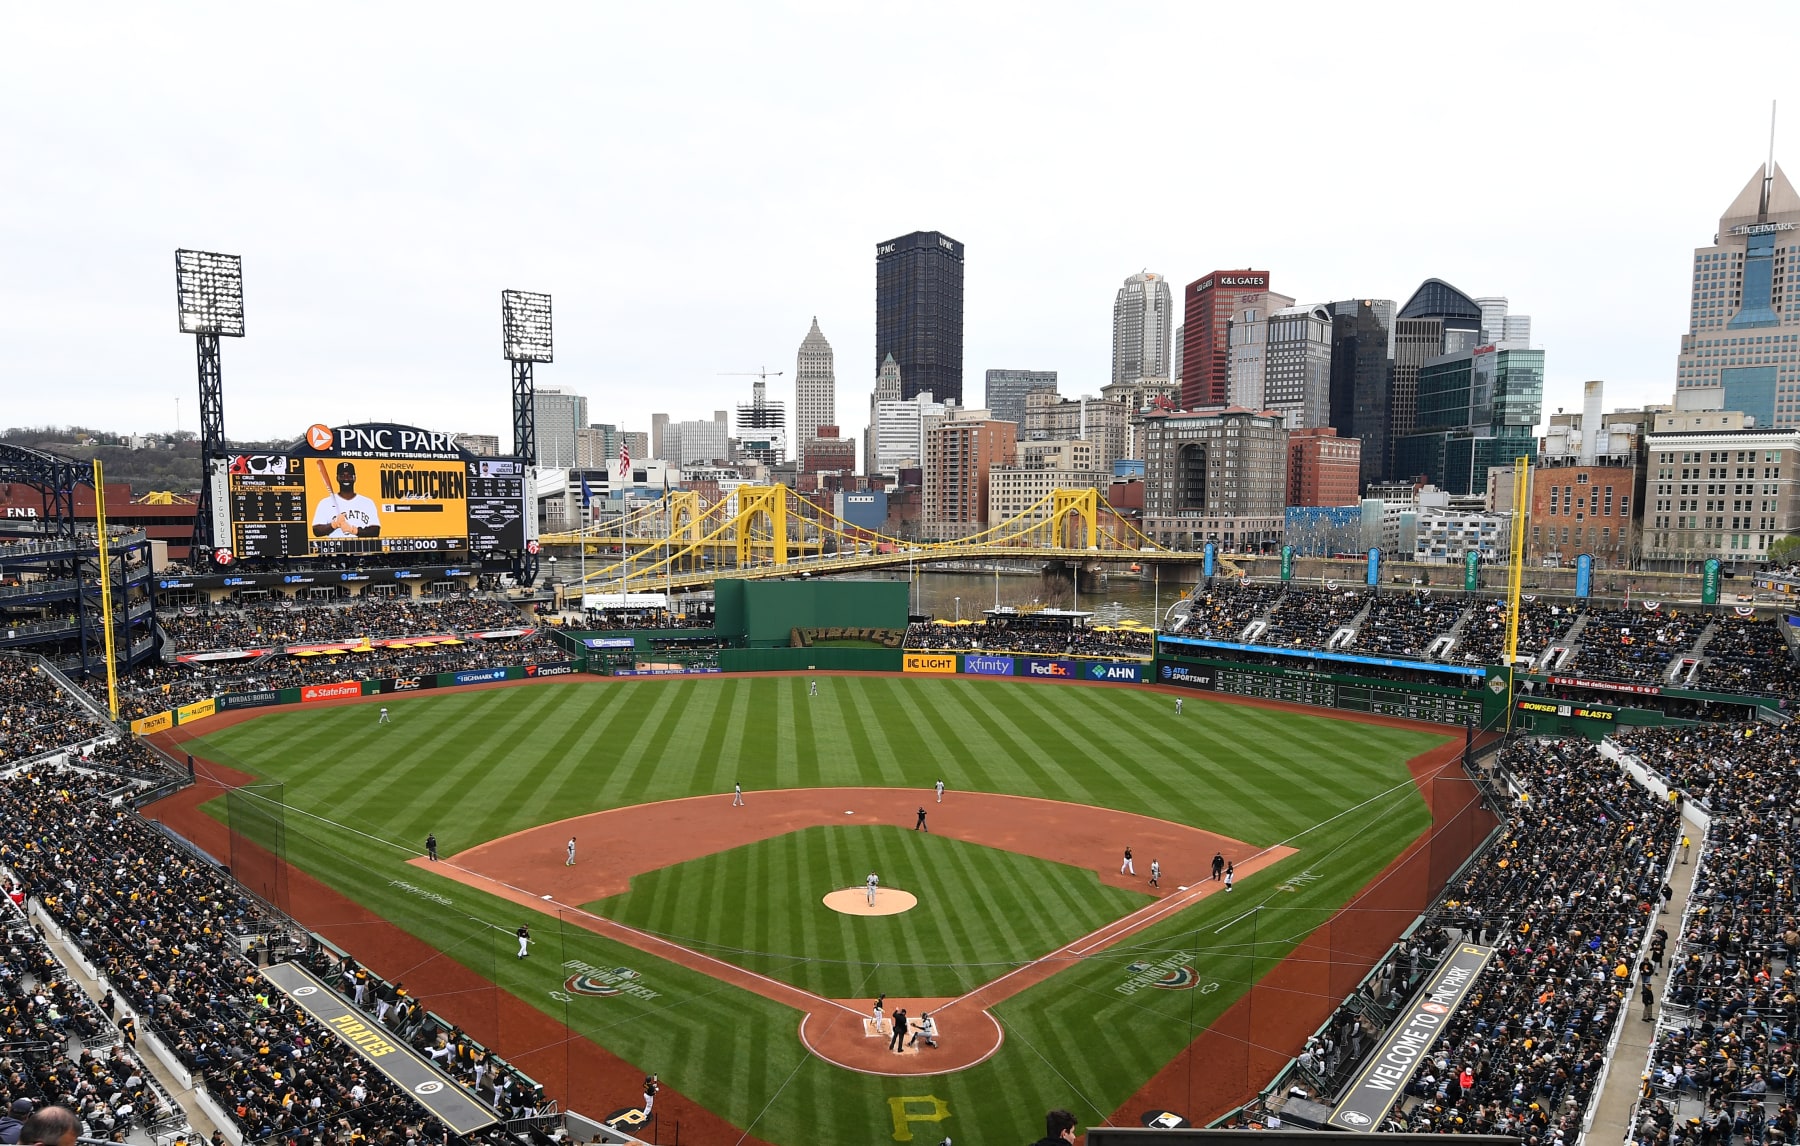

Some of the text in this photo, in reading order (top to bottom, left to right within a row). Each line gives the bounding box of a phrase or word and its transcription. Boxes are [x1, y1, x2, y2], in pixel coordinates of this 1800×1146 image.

[1736, 222, 1794, 235] HIGHMARK
[877, 243, 895, 255] UPMC
[940, 237, 954, 251] UPMC
[337, 428, 460, 451] PNC PARK
[290, 459, 300, 472] P
[380, 470, 464, 499] MCCUTCHEN
[800, 627, 905, 647] PIRATES
[908, 659, 951, 668] IC LIGHT
[968, 659, 1009, 674] xfinity
[1030, 662, 1065, 675] FedEx
[538, 666, 571, 676] Fanatics
[1107, 668, 1134, 679] AHN
[394, 677, 421, 689] DLC
[461, 674, 492, 682] HIGHMARK
[1172, 673, 1210, 684] SPORTSNET
[1355, 683, 1464, 700] AMERICAN LEAGUE
[1590, 681, 1618, 690] delicious
[228, 696, 250, 704] BORDAS
[198, 704, 214, 714] LOTTERY
[1524, 703, 1556, 712] BOWSER
[1580, 710, 1613, 719] BLASTS
[1293, 870, 1324, 887] PNC
[1463, 947, 1486, 956] P
[1157, 951, 1197, 970] WEEK
[561, 959, 663, 1000] OPENING WEEK
[1114, 966, 1169, 996] OPENING
[1365, 966, 1472, 1090] WELCOME TO PNC PARK
[329, 1014, 396, 1057] PIRATES
[606, 1109, 647, 1125] P
[887, 1094, 952, 1140] P
